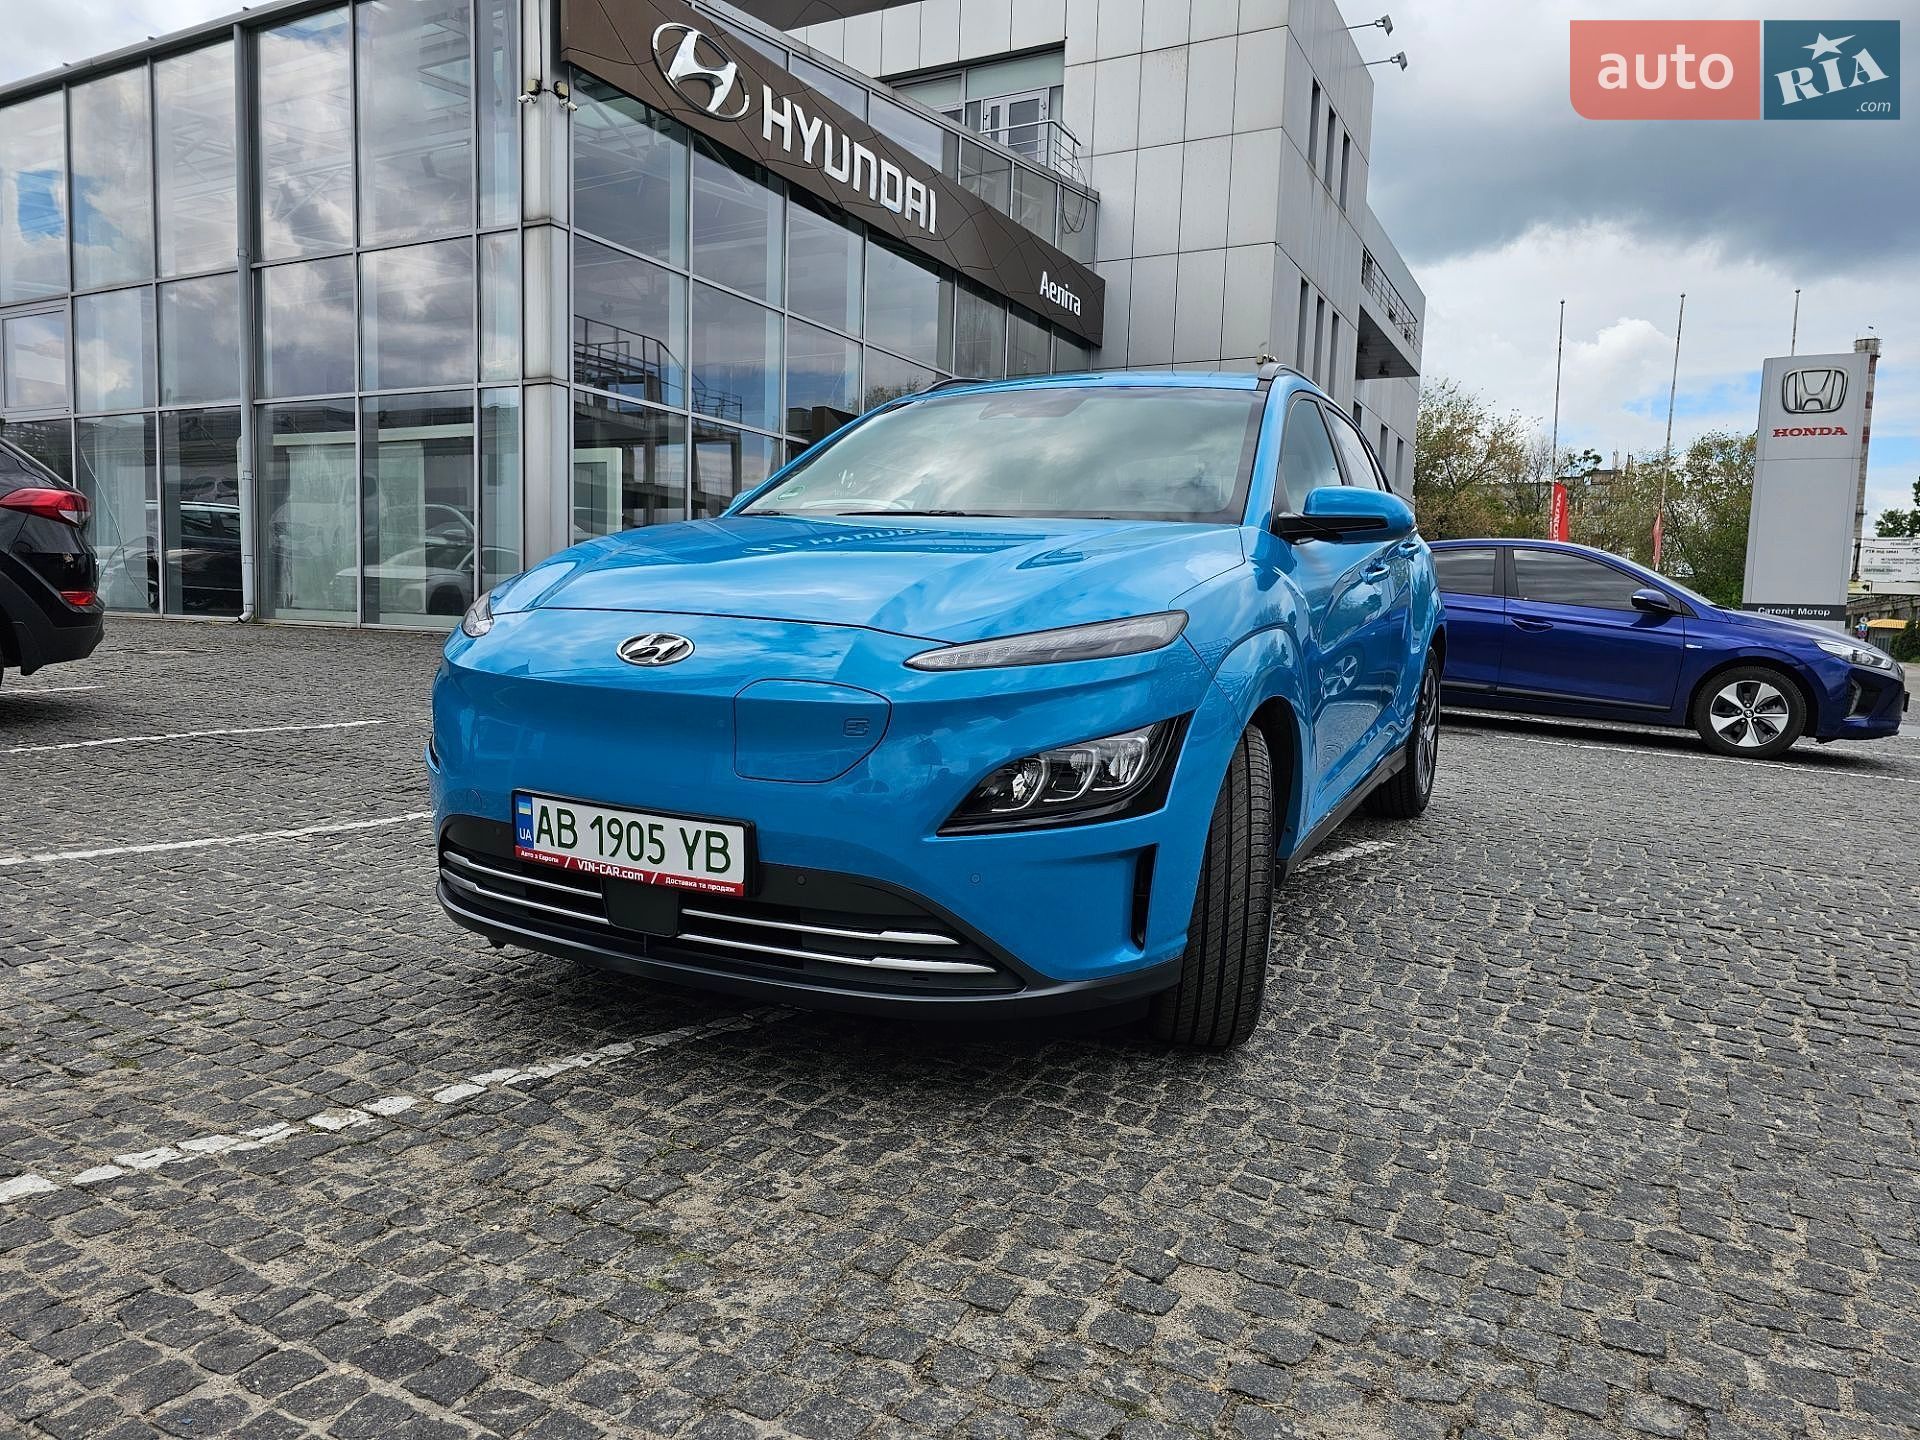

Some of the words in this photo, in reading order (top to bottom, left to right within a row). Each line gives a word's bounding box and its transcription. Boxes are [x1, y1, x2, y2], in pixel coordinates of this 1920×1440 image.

[762, 84, 936, 235] HYUNDAI
[1040, 270, 1081, 317] Аеліта
[1772, 426, 1848, 438] HONDA
[1797, 607, 1831, 617] Мотор
[519, 828, 533, 841] UA
[536, 805, 578, 849] AB
[590, 815, 665, 865] 1905
[679, 827, 731, 874] YB
[577, 859, 644, 881] VIN-CAR.com
[665, 876, 697, 888] Доставка
